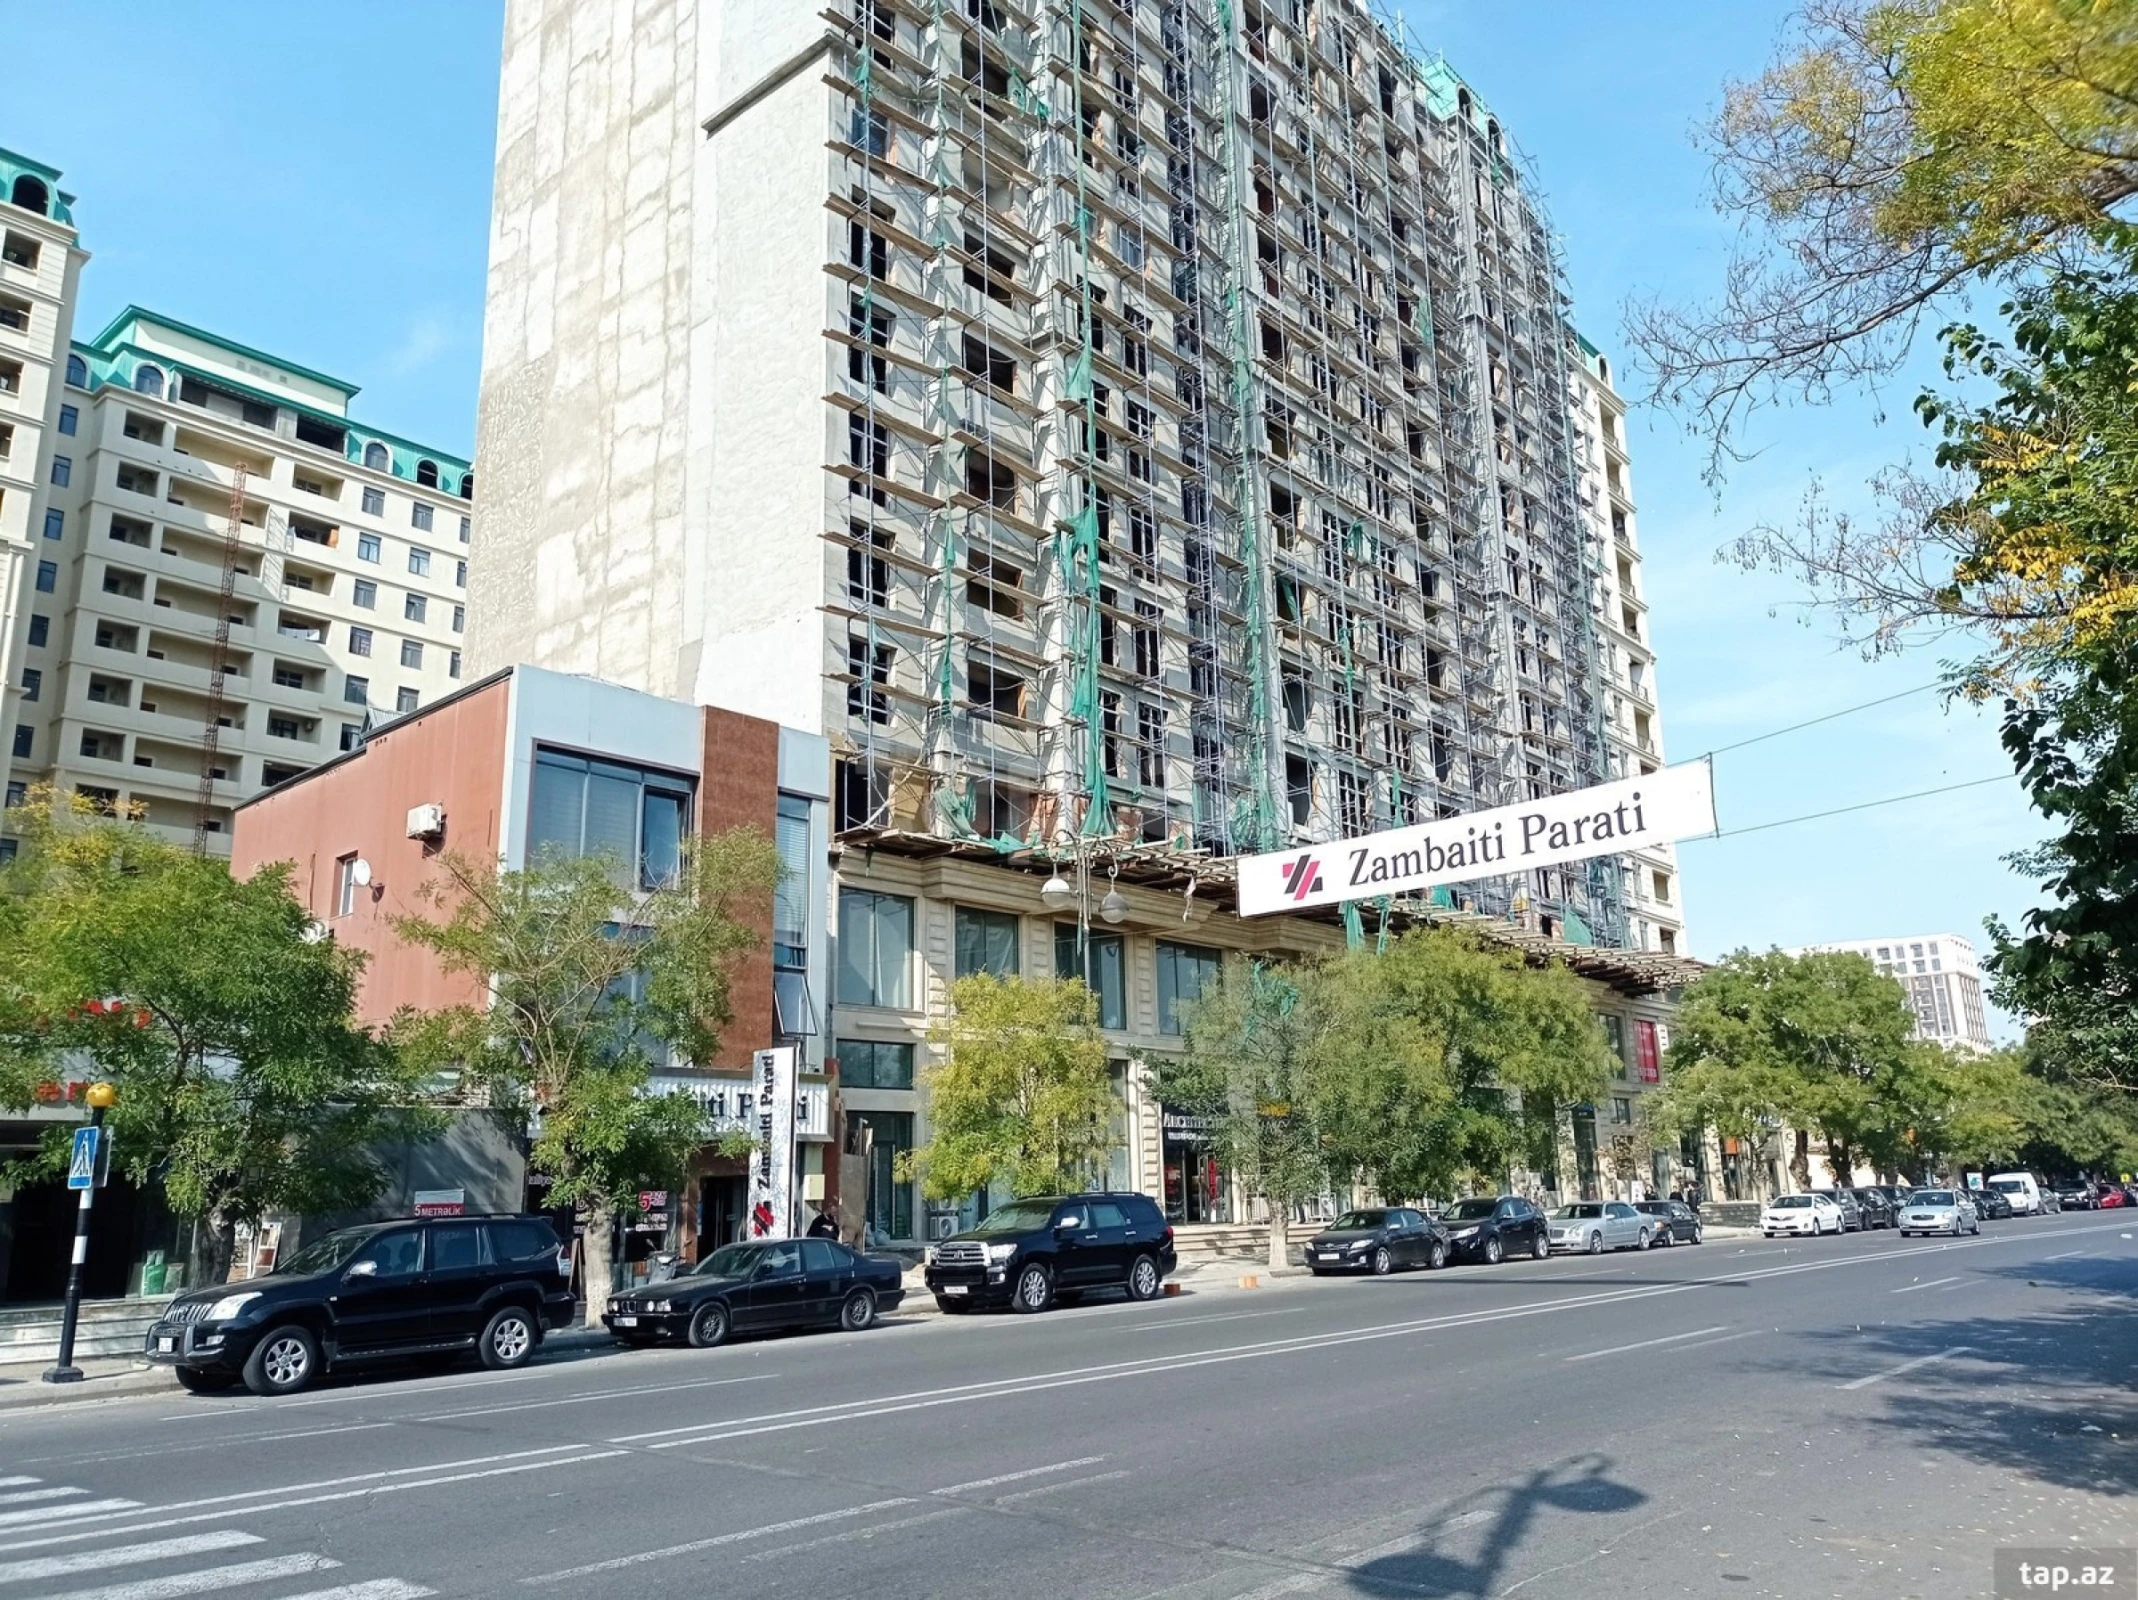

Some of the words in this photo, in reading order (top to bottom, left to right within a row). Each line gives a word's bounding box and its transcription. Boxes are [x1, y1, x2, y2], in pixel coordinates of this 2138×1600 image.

[1349, 822, 1506, 886] Zambaiti
[1519, 792, 1647, 855] Parati
[760, 1054, 774, 1107] Parati
[413, 1204, 421, 1217] 5
